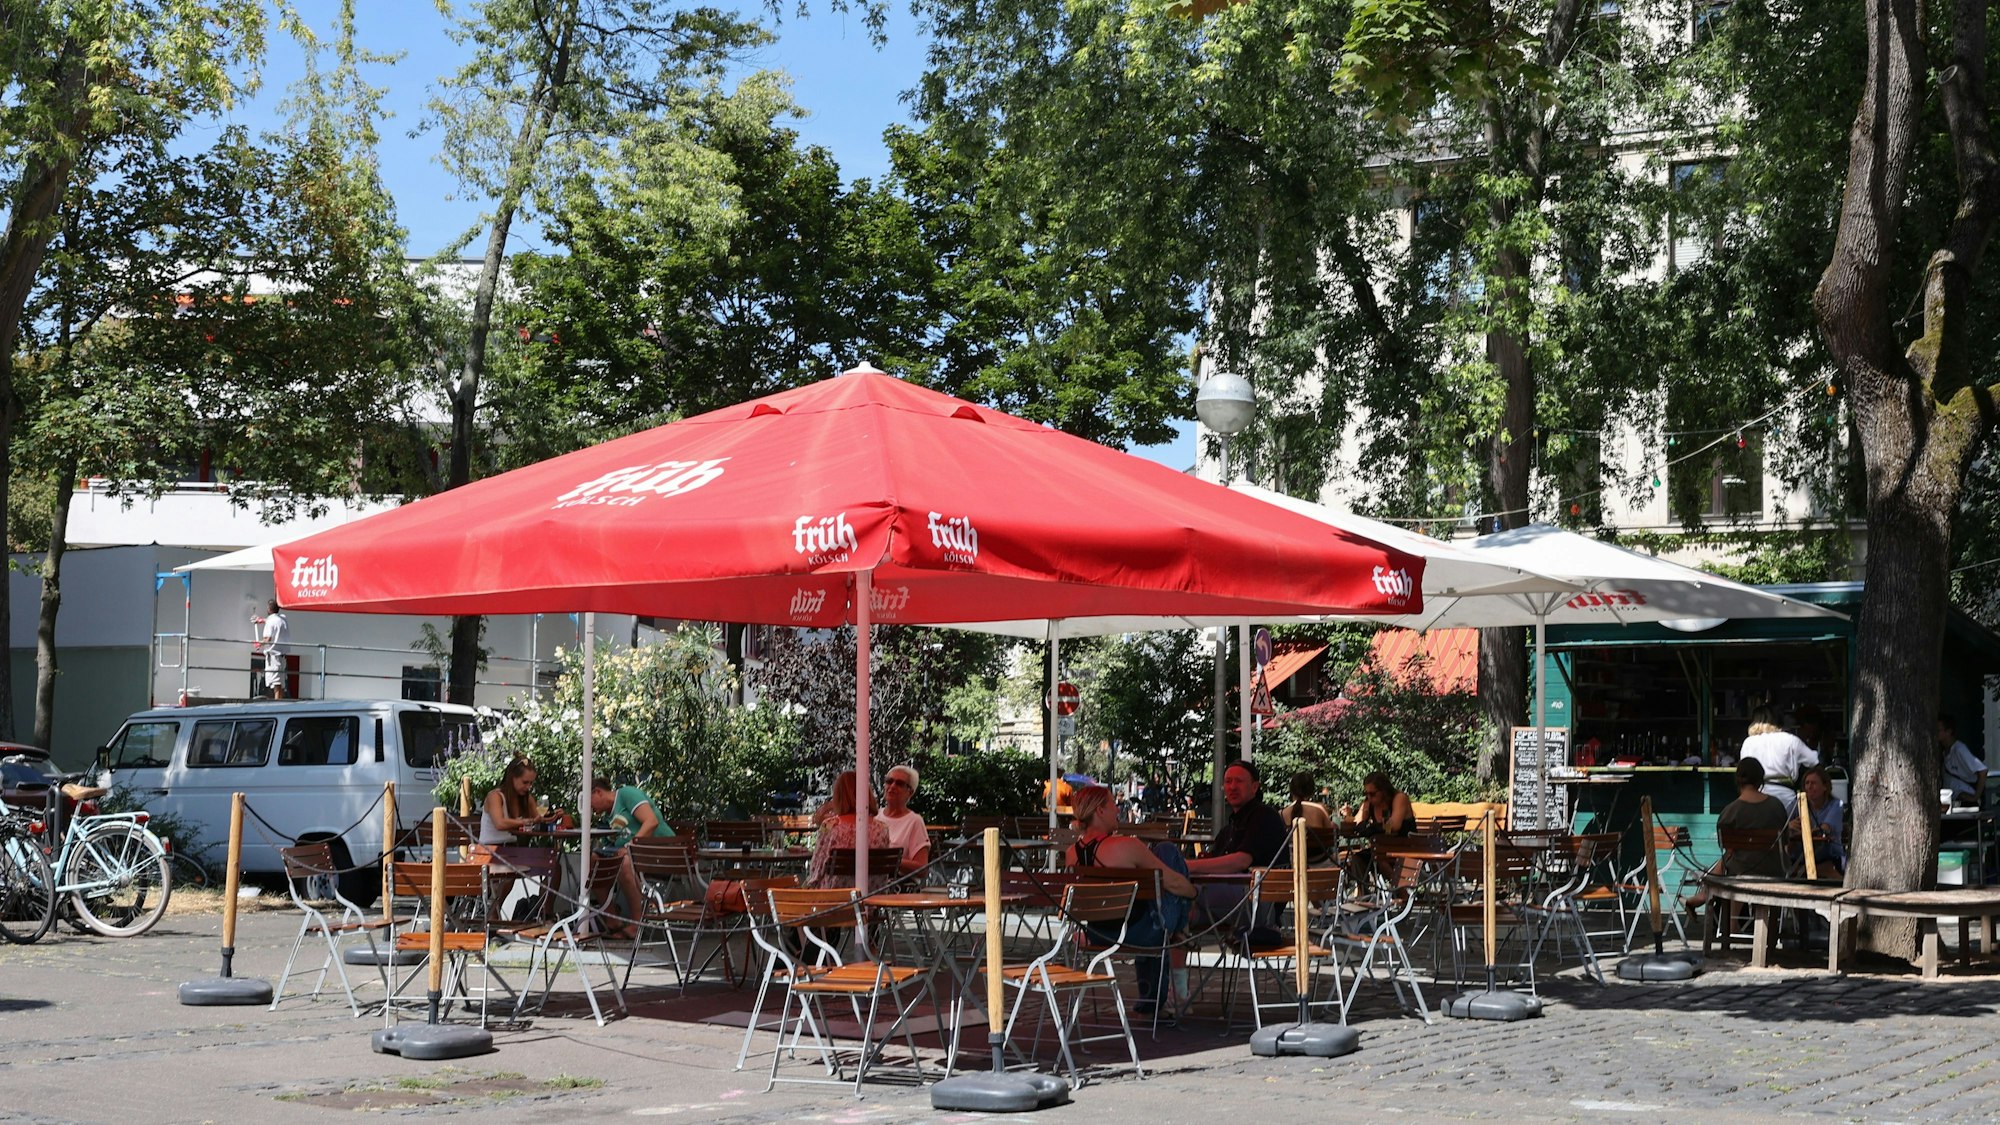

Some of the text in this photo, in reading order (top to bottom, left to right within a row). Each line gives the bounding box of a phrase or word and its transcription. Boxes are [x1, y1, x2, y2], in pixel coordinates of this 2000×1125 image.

[791, 511, 858, 554] früh
[927, 511, 979, 558] früh
[291, 554, 339, 591] früh
[808, 551, 849, 566] KÖLSCH
[943, 551, 974, 565] KÖLSCH
[297, 588, 328, 599] KÖLSCH
[1371, 565, 1413, 601] früh
